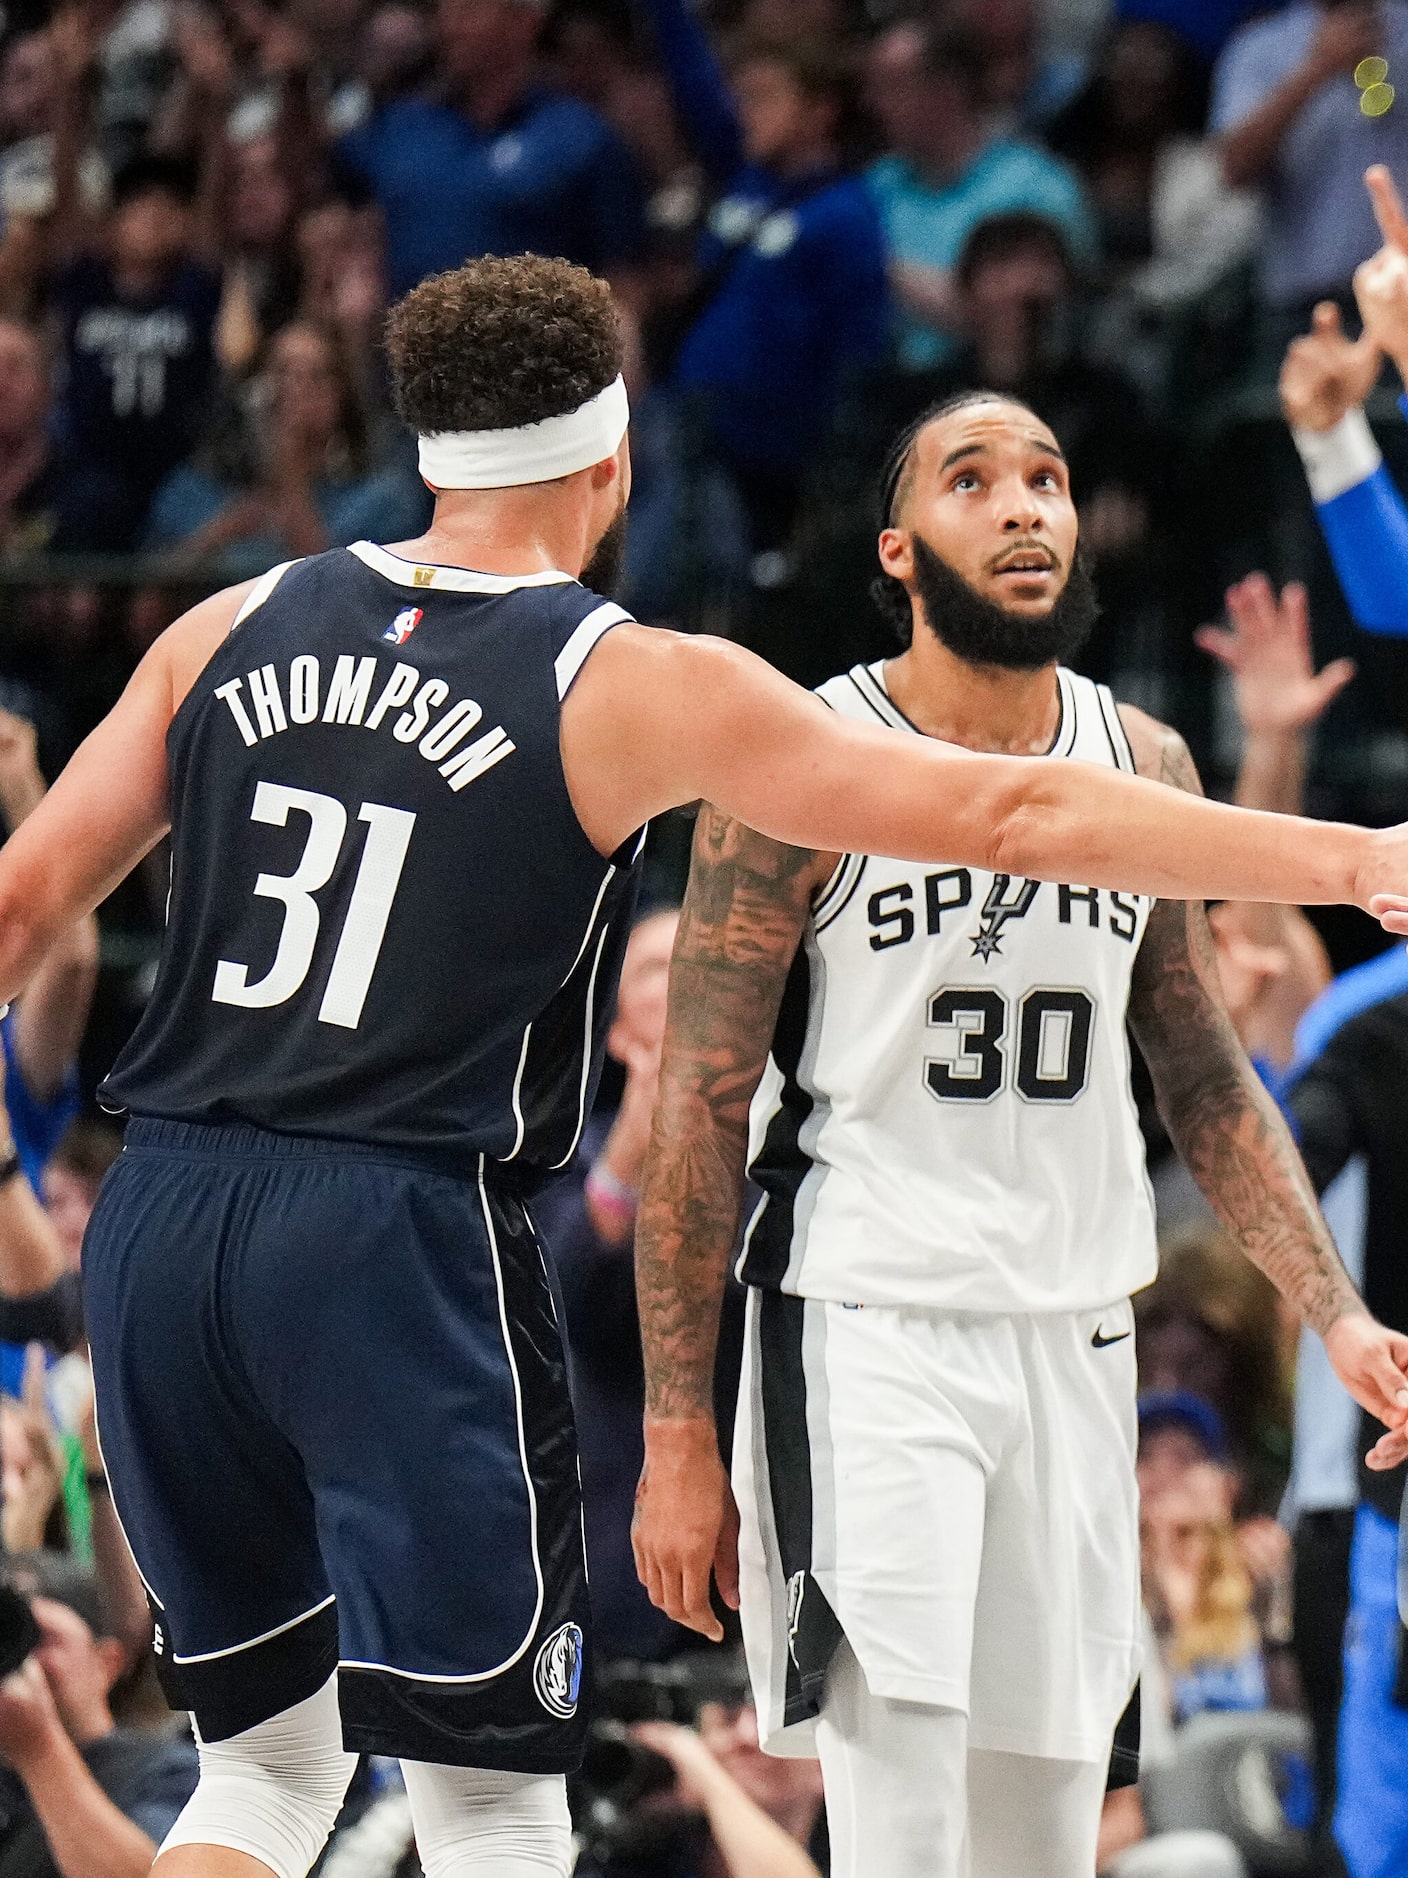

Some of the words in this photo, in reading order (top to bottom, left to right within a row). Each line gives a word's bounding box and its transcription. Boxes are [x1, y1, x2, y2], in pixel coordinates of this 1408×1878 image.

[213, 654, 517, 793] THOMPSON
[211, 780, 417, 1030] 31
[922, 983, 1097, 1105] 30
